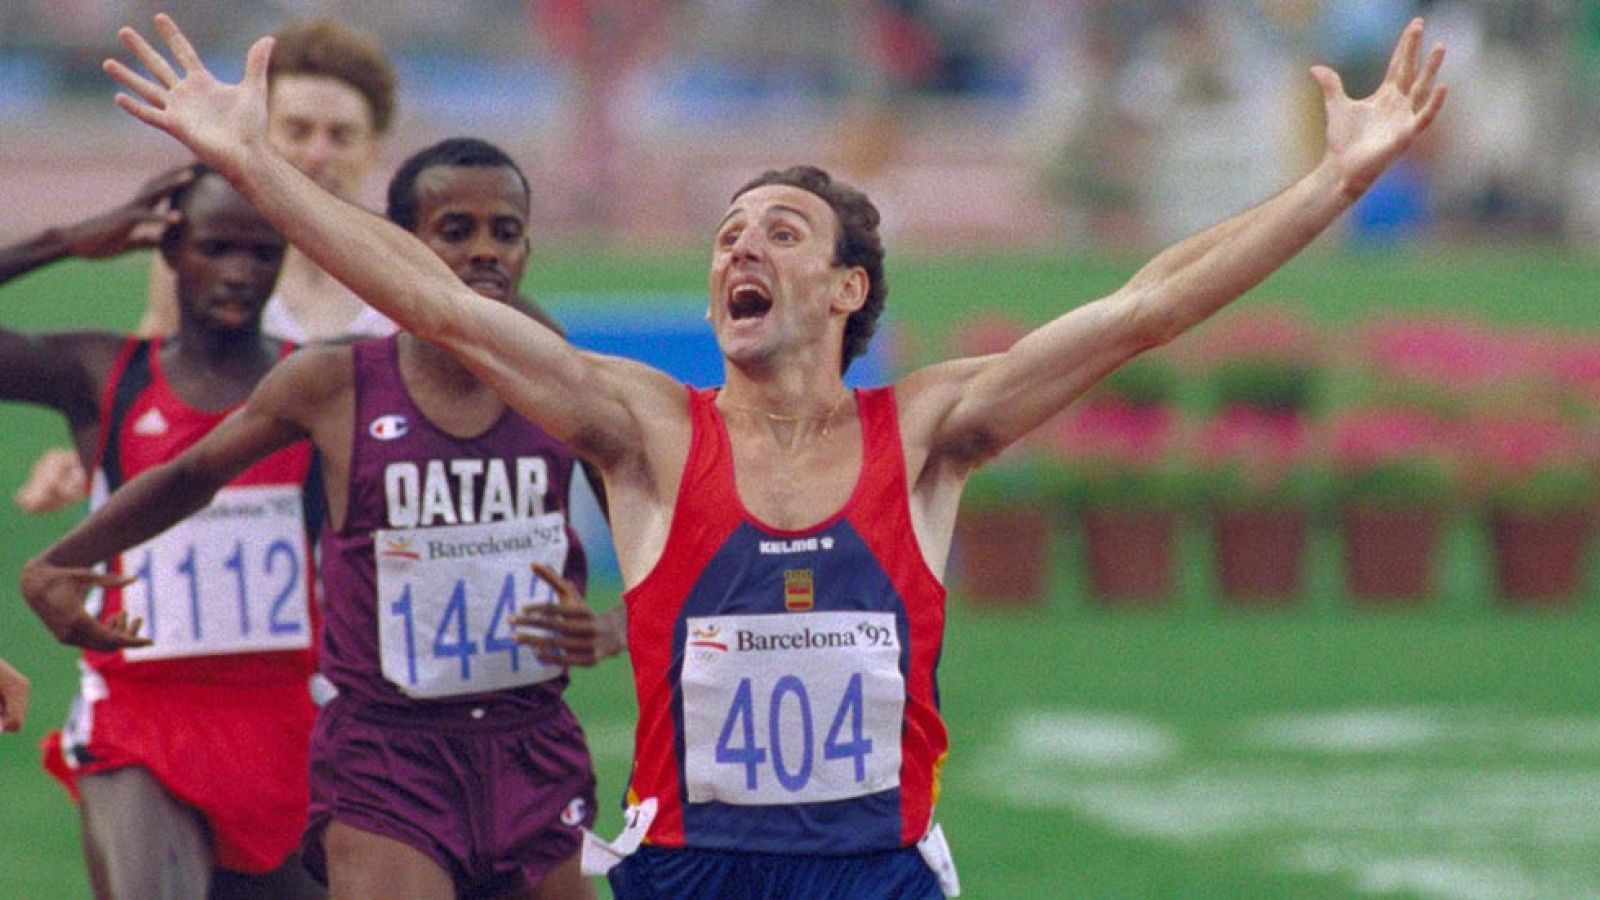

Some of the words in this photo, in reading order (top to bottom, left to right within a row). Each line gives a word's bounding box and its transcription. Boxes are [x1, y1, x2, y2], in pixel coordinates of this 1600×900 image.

[385, 457, 548, 528] QATAR
[760, 538, 818, 554] KELME
[137, 535, 302, 642] 1112
[736, 628, 856, 651] Barcelona
[715, 673, 873, 792] 404
